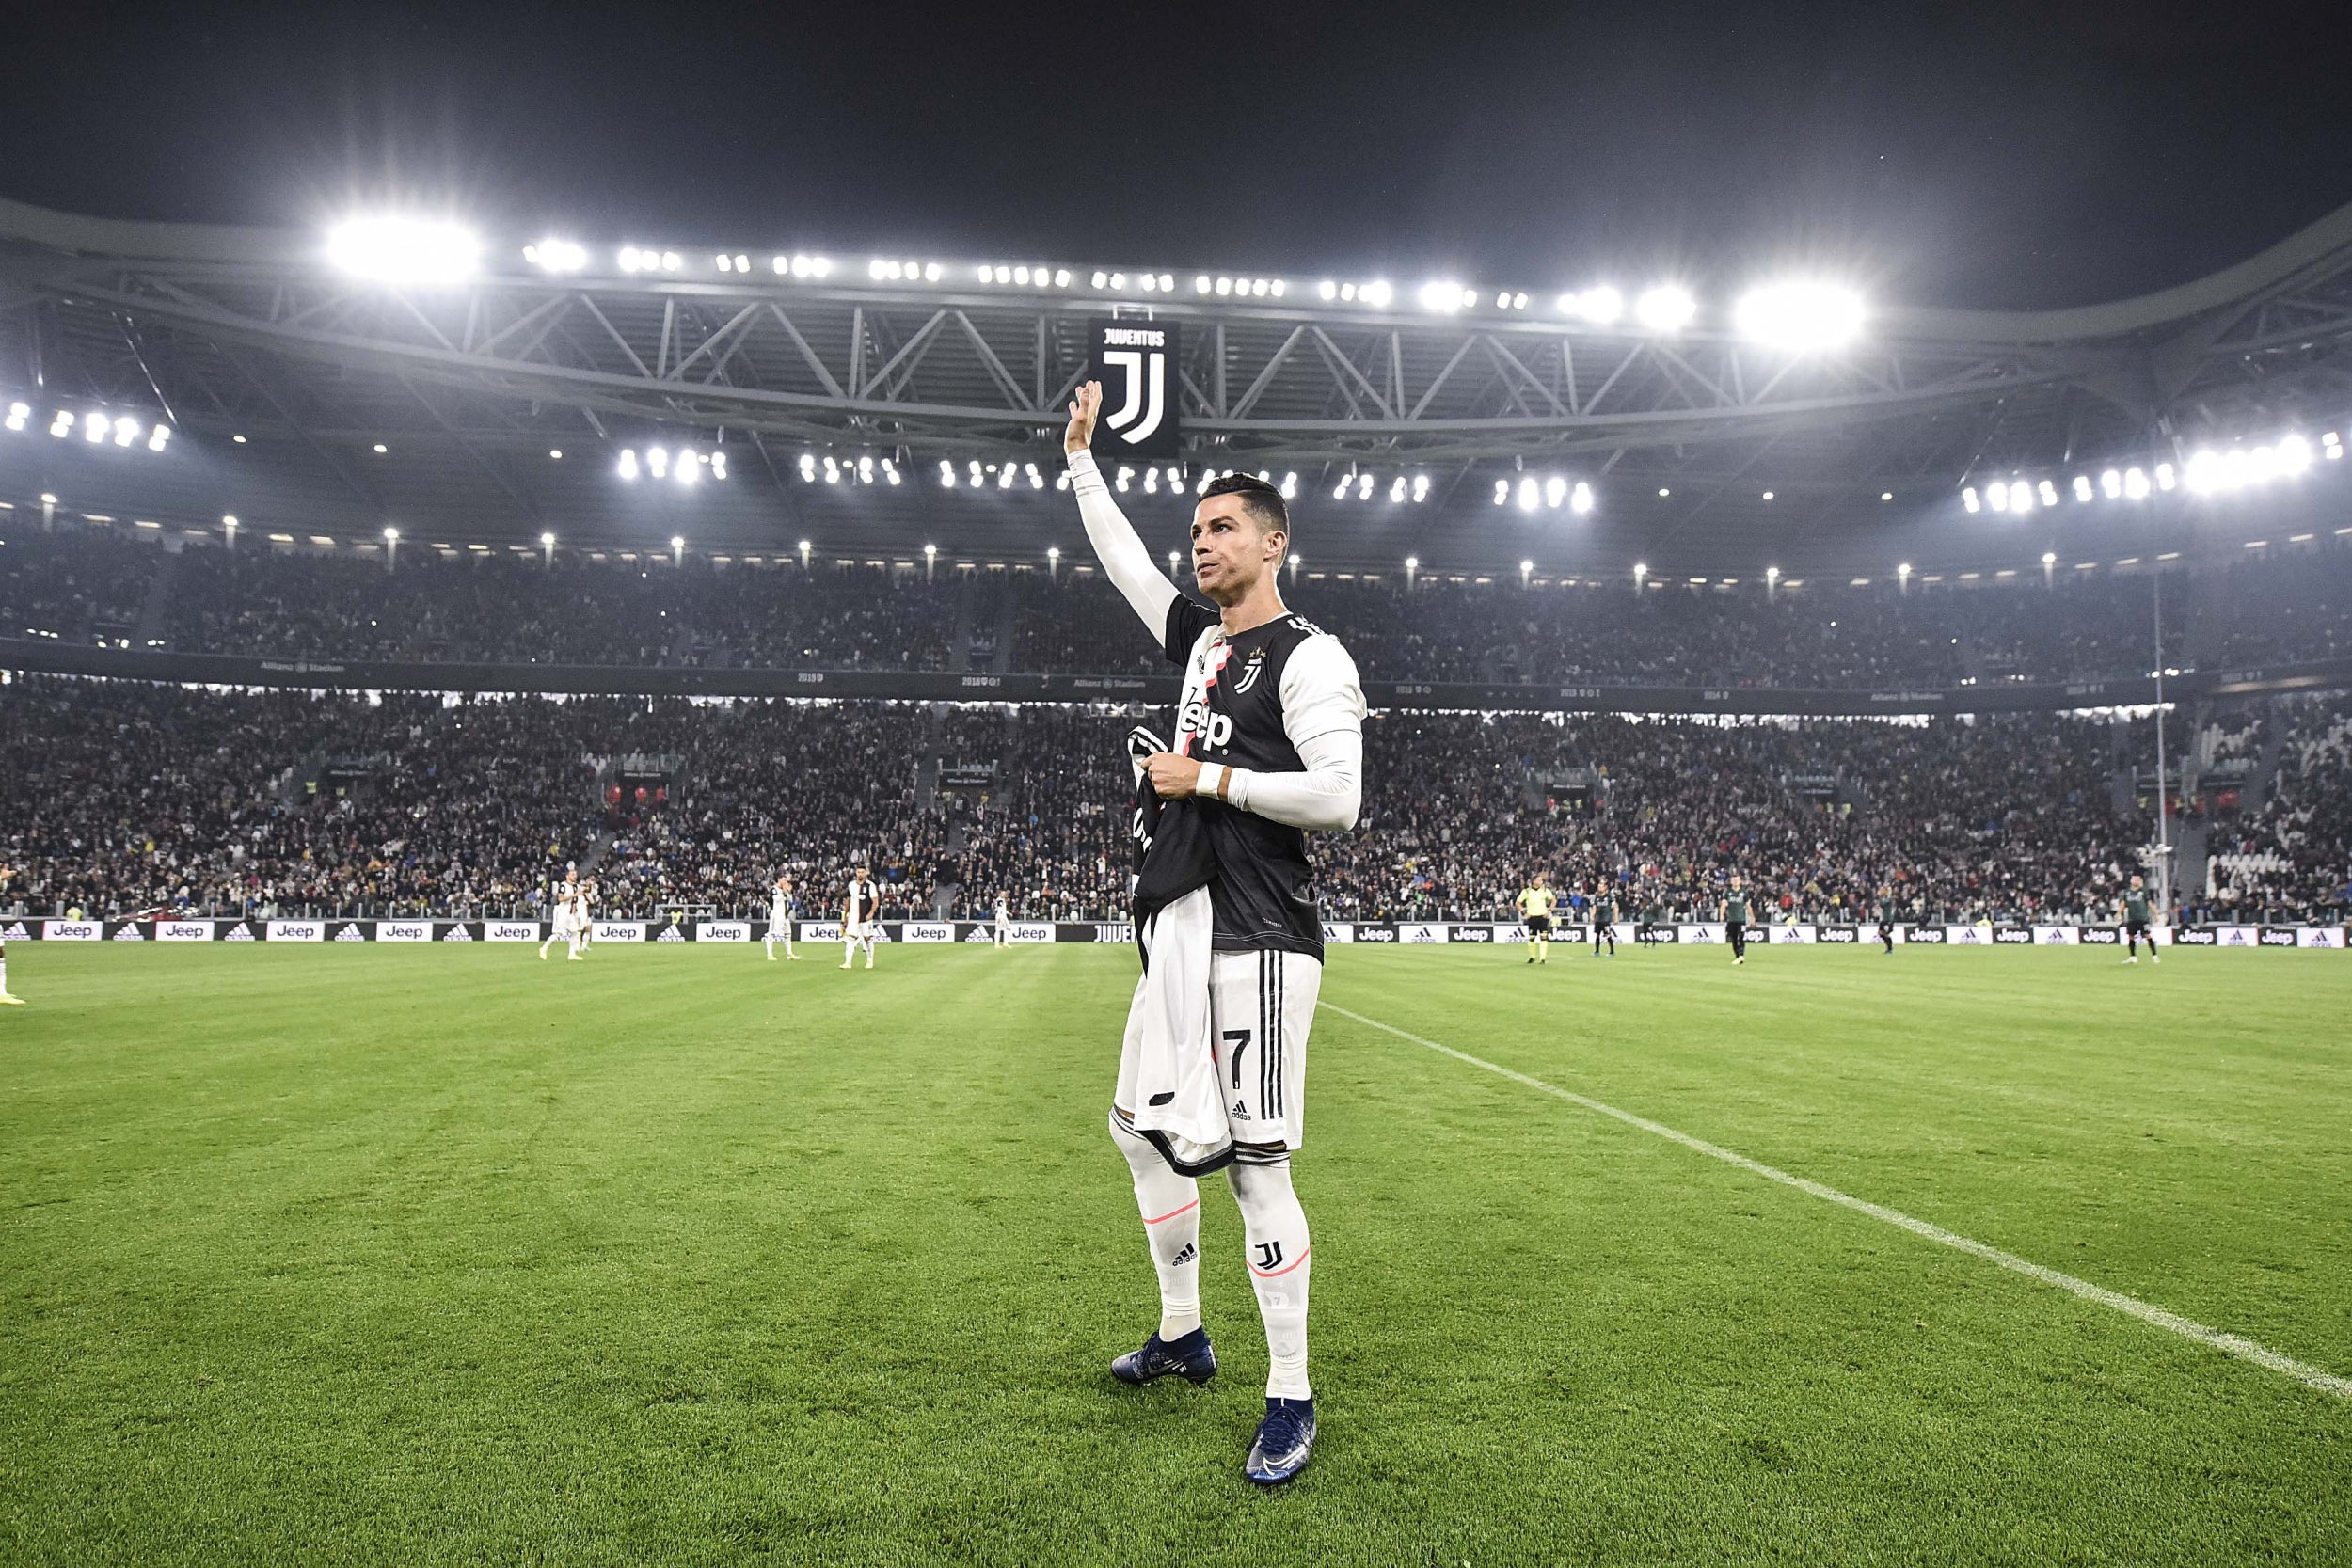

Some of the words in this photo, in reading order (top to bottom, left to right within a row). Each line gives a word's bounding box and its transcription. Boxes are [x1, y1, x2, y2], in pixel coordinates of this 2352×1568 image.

[1104, 327, 1165, 347] JUVENTUS
[1073, 679, 1102, 688] Allianz
[54, 924, 93, 939] Jeep
[166, 925, 205, 939] Jeep
[277, 925, 315, 939] Jeep
[386, 926, 423, 940] Jeep
[494, 926, 532, 940] Jeep
[600, 927, 637, 940] Jeep
[706, 927, 742, 940] Jeep
[911, 927, 946, 940] Jeep
[1012, 927, 1047, 941] Jeep
[1359, 927, 1394, 942] Jeep
[1454, 927, 1489, 942] Jeep
[1548, 927, 1581, 942] Jeep
[1820, 927, 1854, 942] Jeep
[1909, 928, 1943, 943] Jeep
[1996, 928, 2030, 943] Jeep
[2083, 928, 2116, 943] Jeep
[2178, 928, 2214, 944] Jeep
[2261, 929, 2294, 945] Jeep
[1223, 1029, 1251, 1090] 7
[1231, 1111, 1251, 1121] adidas
[1172, 1251, 1198, 1267] adidas
